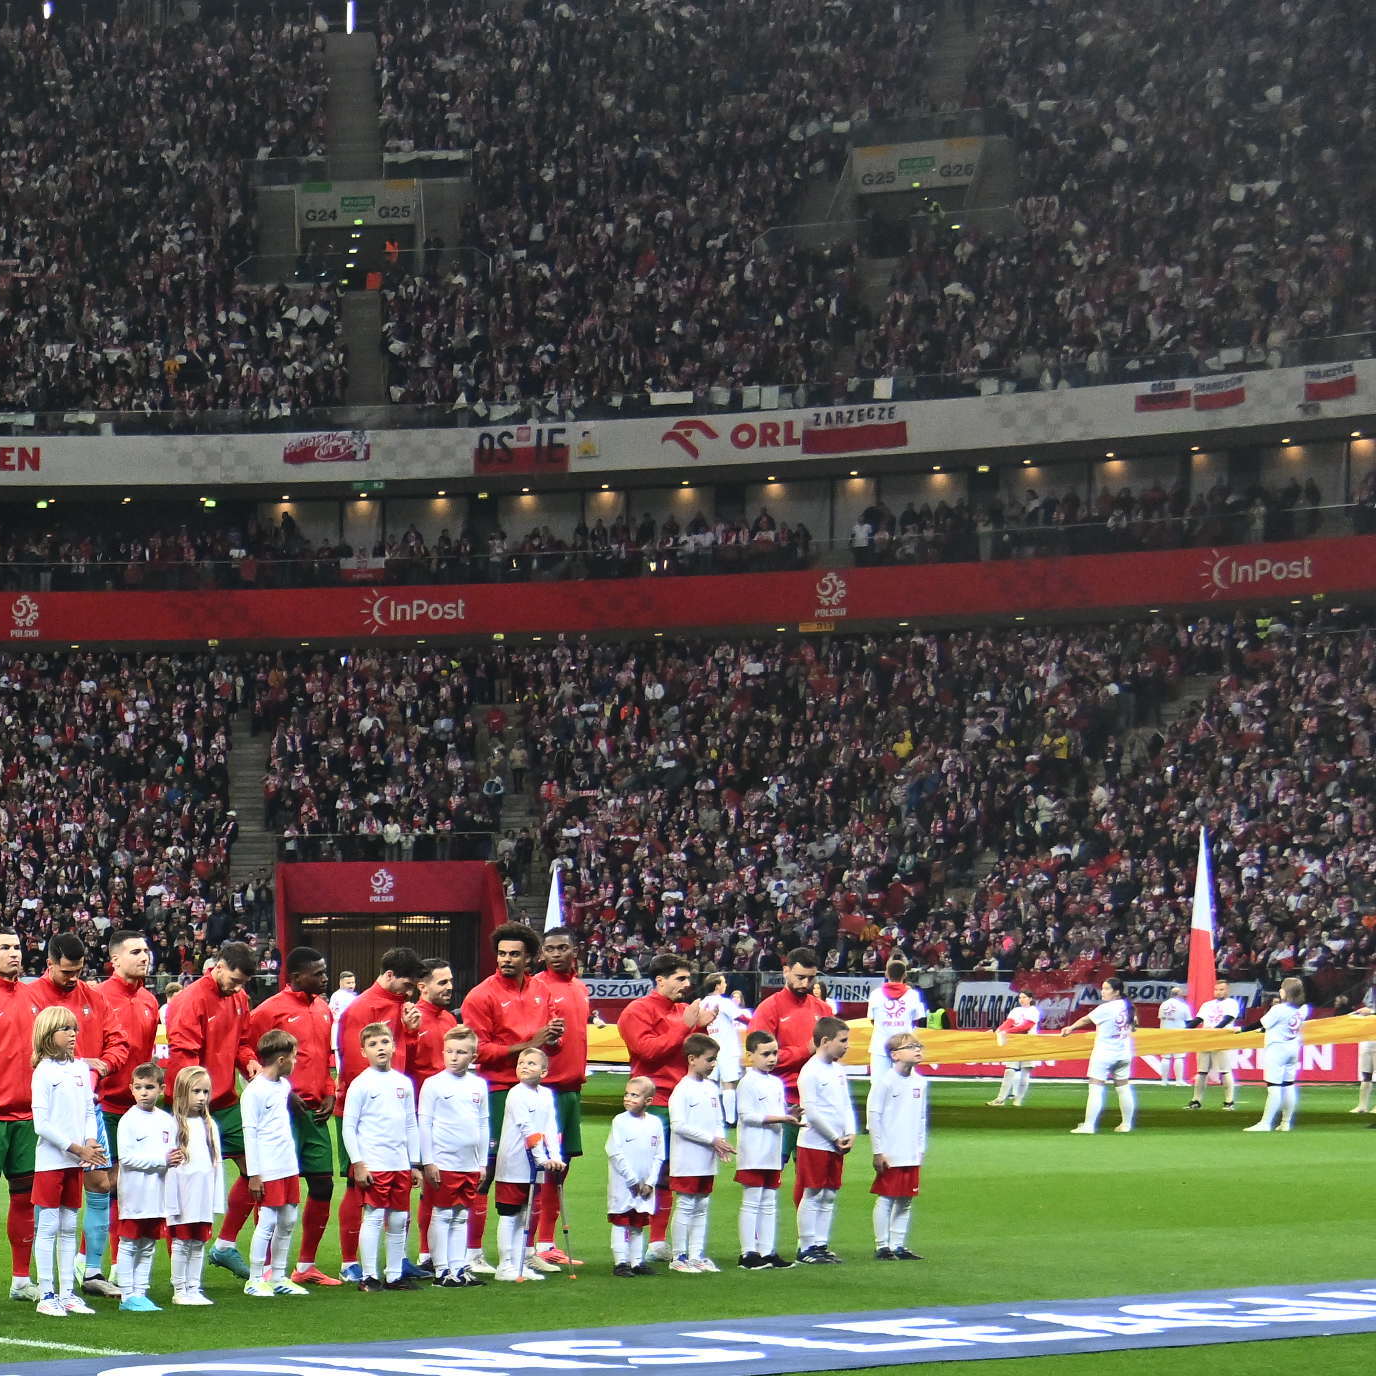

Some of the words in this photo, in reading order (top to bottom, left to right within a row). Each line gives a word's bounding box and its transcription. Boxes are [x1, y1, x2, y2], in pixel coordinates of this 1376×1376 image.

[861, 171, 897, 186] G25
[305, 208, 337, 222] G24
[379, 205, 410, 220] G25
[813, 405, 897, 427] ZARZECZE
[730, 420, 802, 450] ORL
[1230, 554, 1313, 585] InPost
[389, 598, 466, 622] InPost
[815, 607, 848, 618] POLSKA
[10, 628, 40, 639] POLSKA
[368, 894, 395, 904] POLSKA
[825, 980, 870, 1003] ŻAGAŃ
[676, 1287, 1376, 1353] LEAG
